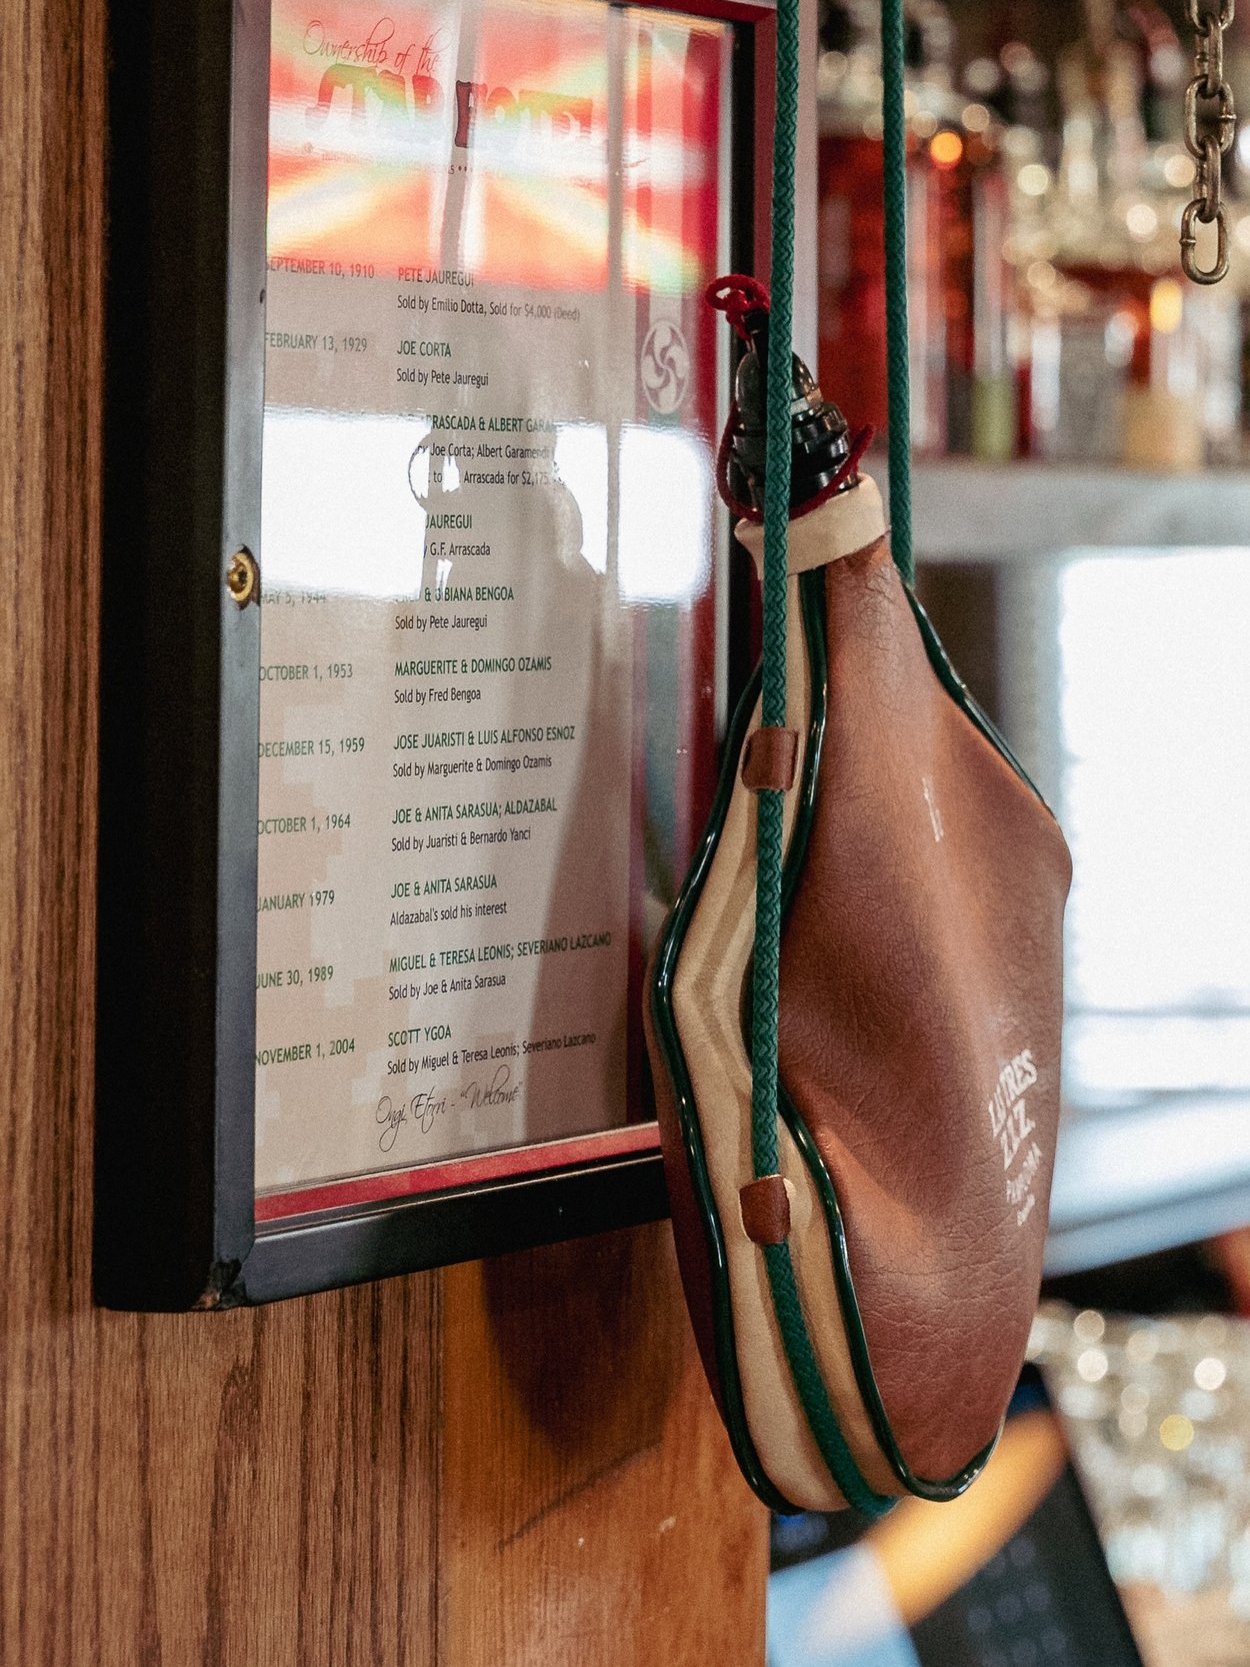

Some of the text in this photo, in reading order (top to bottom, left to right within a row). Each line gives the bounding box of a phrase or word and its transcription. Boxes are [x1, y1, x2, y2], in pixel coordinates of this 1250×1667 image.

[303, 18, 395, 68] Ownership
[395, 44, 415, 76] of
[267, 257, 375, 278] EPTEMBER 10, 1910
[398, 267, 474, 287] PETE JAUREGUI
[397, 295, 416, 310] Sold
[419, 297, 429, 313] by
[432, 297, 458, 312] Emilio
[461, 300, 486, 317] Dotta,
[489, 302, 507, 316] Sold
[510, 303, 521, 317] for
[524, 303, 551, 319] $4,000
[322, 336, 337, 353] 13,
[343, 338, 367, 352] 1929
[397, 341, 452, 357] JOE CORTA
[396, 368, 489, 389] Sold by Pete Jauregui
[479, 416, 486, 431] &
[488, 417, 523, 432] ALBERT
[430, 443, 446, 456] Joe
[448, 443, 475, 459] Corta;
[477, 444, 503, 458] Albert
[464, 470, 504, 484] Arrascada
[507, 471, 519, 484] for
[426, 514, 472, 529] JAUREGUI
[430, 542, 447, 556] G.F.
[449, 542, 491, 556] Arrascada
[424, 587, 431, 602] &
[475, 586, 514, 601] BENGOA
[395, 614, 488, 632] Sold by Pete Jauregui
[259, 664, 353, 681] OCTOBER 1, 1953
[395, 656, 552, 676] MARGUERITE & DOMINGO OZAMIS
[394, 687, 481, 705] Sold by Fred Bengoa
[258, 737, 365, 757] DECEMBER 15, 1959
[394, 725, 575, 750] JOSE JUARISTI & LUIS ALFONSO ESNOZ
[393, 754, 552, 779] Sold by Marguerite & Domingo Ozamis
[392, 798, 558, 824] JOE & ANITA SARASUA; ALDAZABAL
[257, 814, 351, 835] OCTOBER 1, 1964
[391, 826, 531, 853] Sold by Juaristi & Bernardo Yanci
[391, 874, 497, 898] JOE & ANITA SARASUA
[257, 890, 335, 912] JANUARY 1979
[390, 901, 507, 926] Aldazabal's sold his interest
[389, 932, 611, 972] MIGUEL & TERESA LEONIS; SEVERIANO LAZCANO
[255, 965, 333, 989] JUNE 30, 1989
[389, 974, 506, 1000] Sold by Joe & Anita Sarasua
[388, 1025, 452, 1047] SCOTT YGOA
[255, 1038, 355, 1066] NOVEMBER 1, 2004
[387, 1033, 597, 1075] Sold by Miguel & Teresa Leonis; Severiano Lazcano
